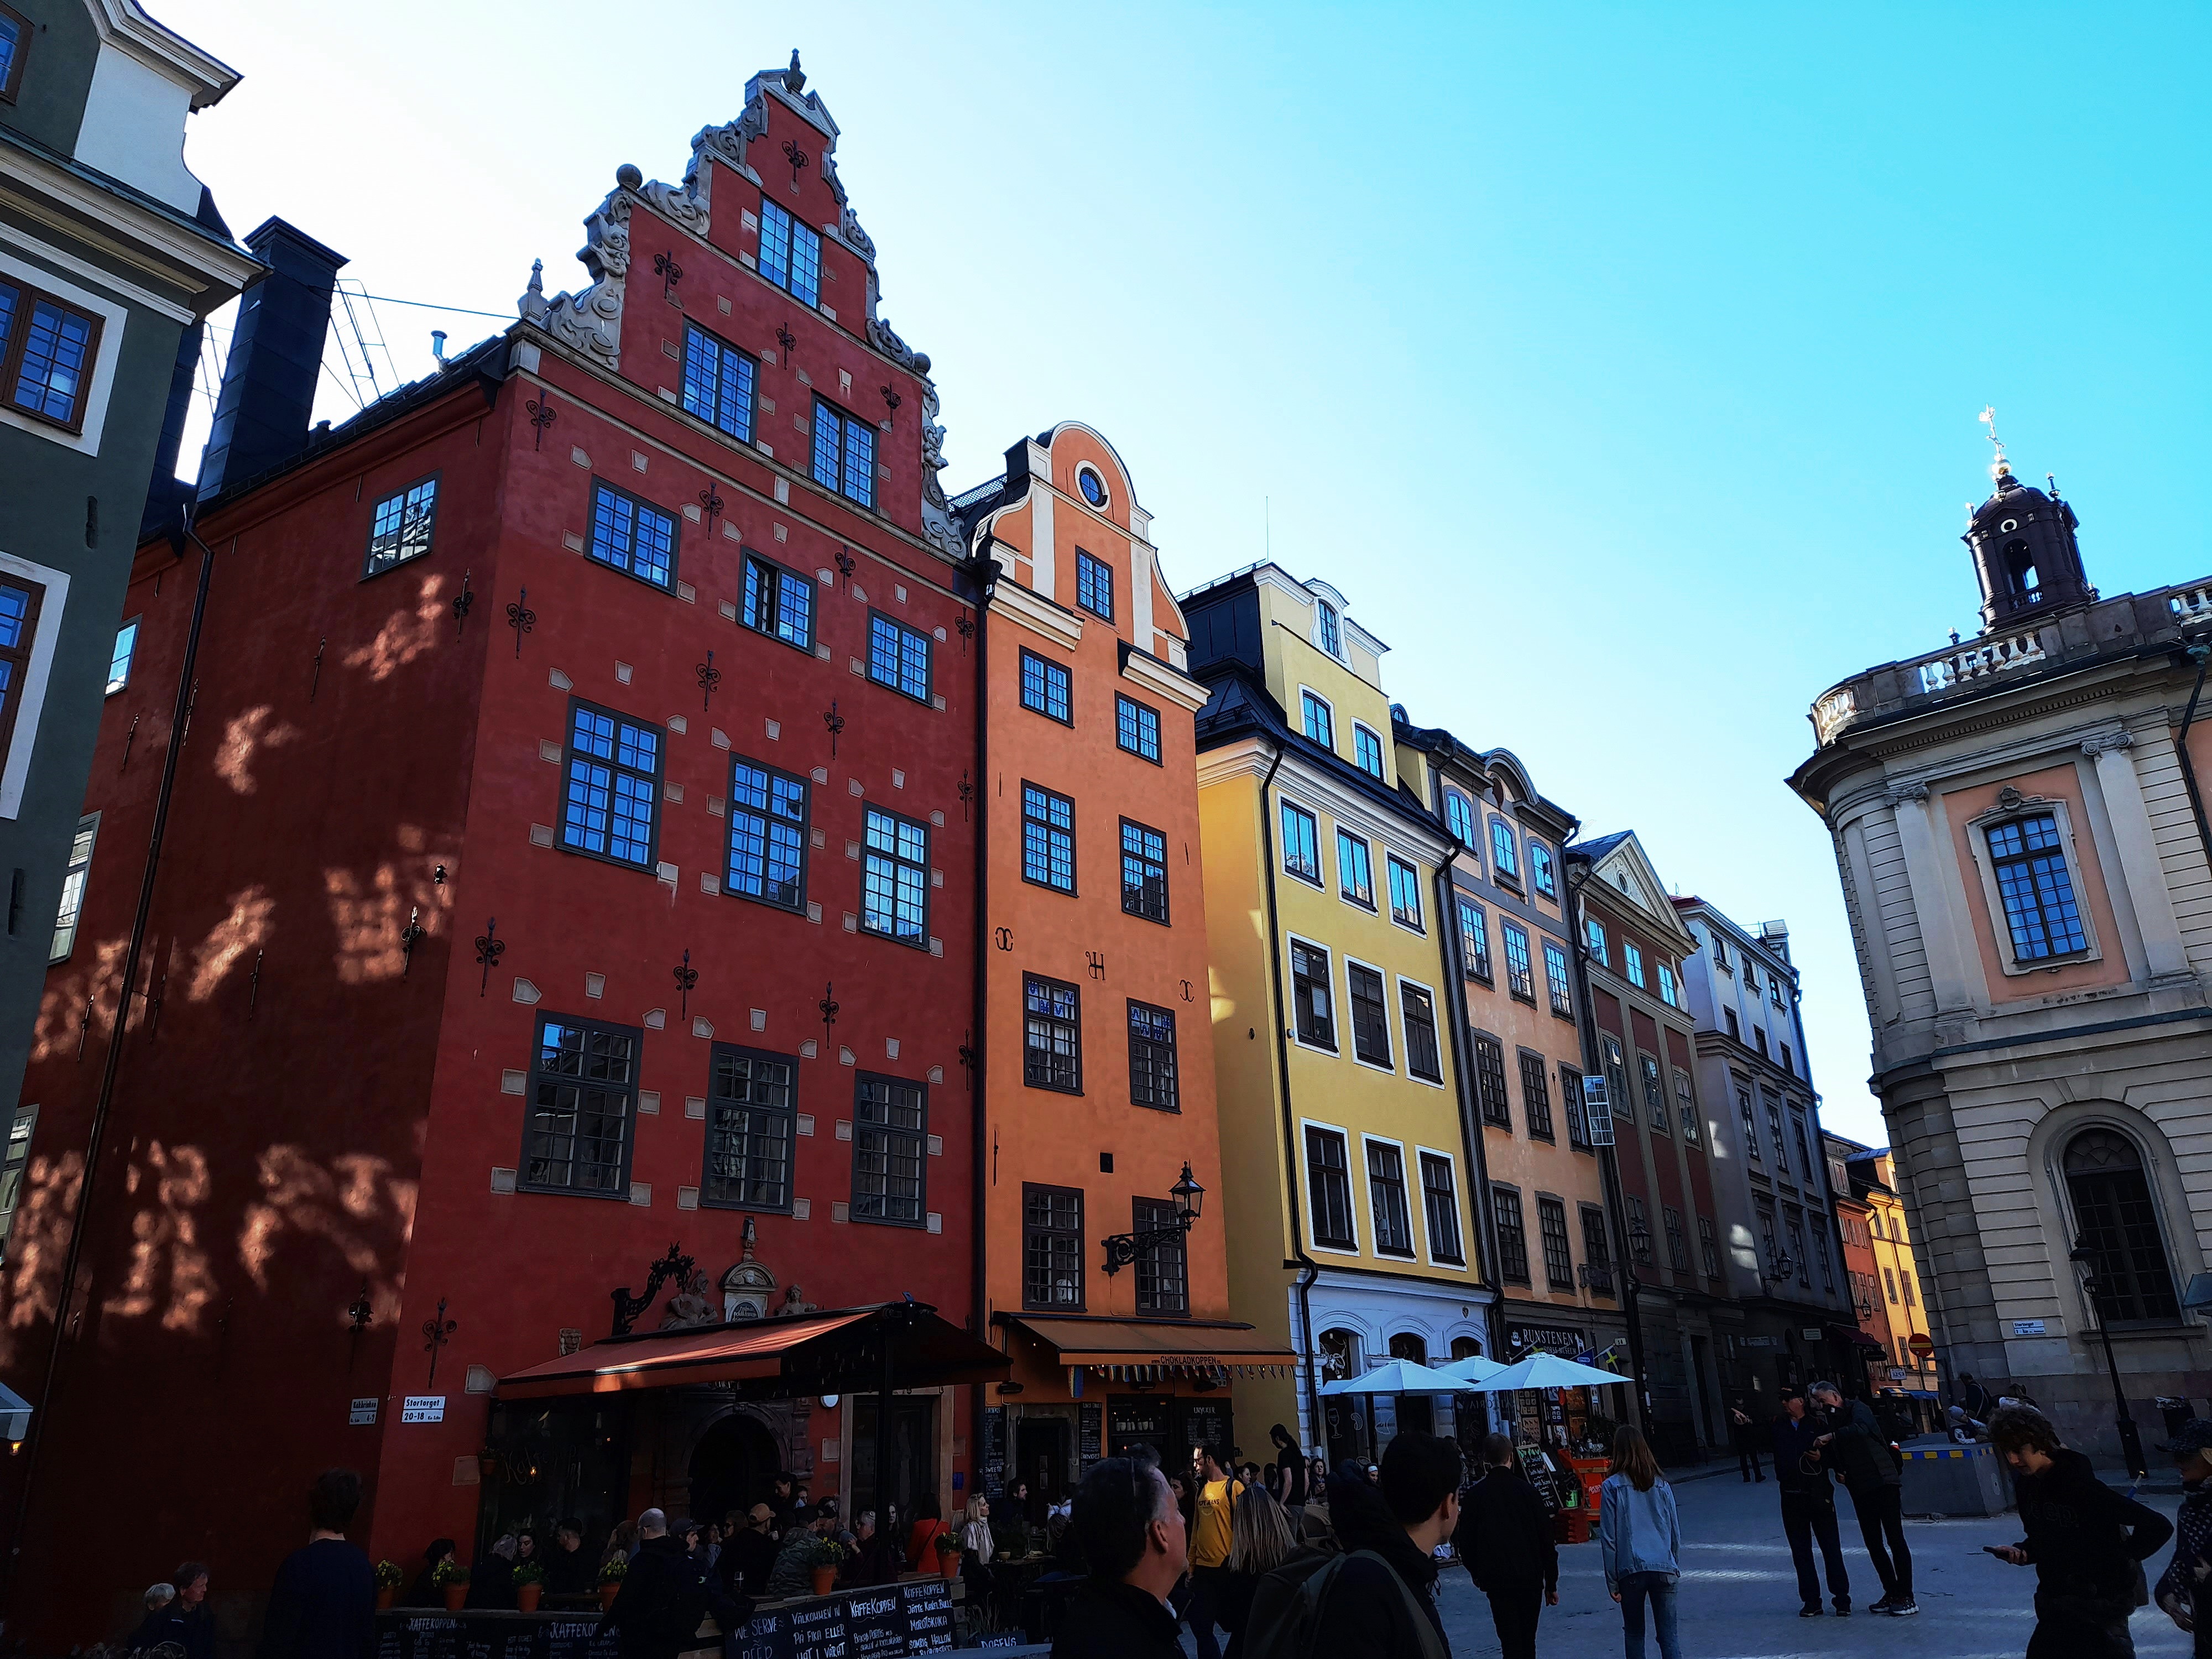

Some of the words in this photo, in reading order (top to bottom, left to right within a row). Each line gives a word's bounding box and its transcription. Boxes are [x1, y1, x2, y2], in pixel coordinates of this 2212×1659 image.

[1523, 1328, 1573, 1345] RUNSTENEN
[1160, 1356, 1217, 1364] CHOKLADKOPPEN
[406, 1399, 440, 1408] Stortorget
[404, 1412, 425, 1421] 20-18
[904, 1581, 945, 1599] KAFFEKOPPEN
[791, 1606, 832, 1625] VÄLKOMMEN
[834, 1604, 841, 1616] IN
[849, 1596, 896, 1618] KAFFEKOPPEN
[409, 1618, 456, 1631] KAFFEKOPPEN
[734, 1625, 749, 1641] WE
[752, 1616, 778, 1637] SERVE
[910, 1616, 947, 1631] MOROTSKAKA
[793, 1630, 804, 1645] PÅ
[807, 1629, 822, 1642] FIKA
[825, 1624, 846, 1639] ELLER
[824, 1641, 846, 1658] VÅRAT
